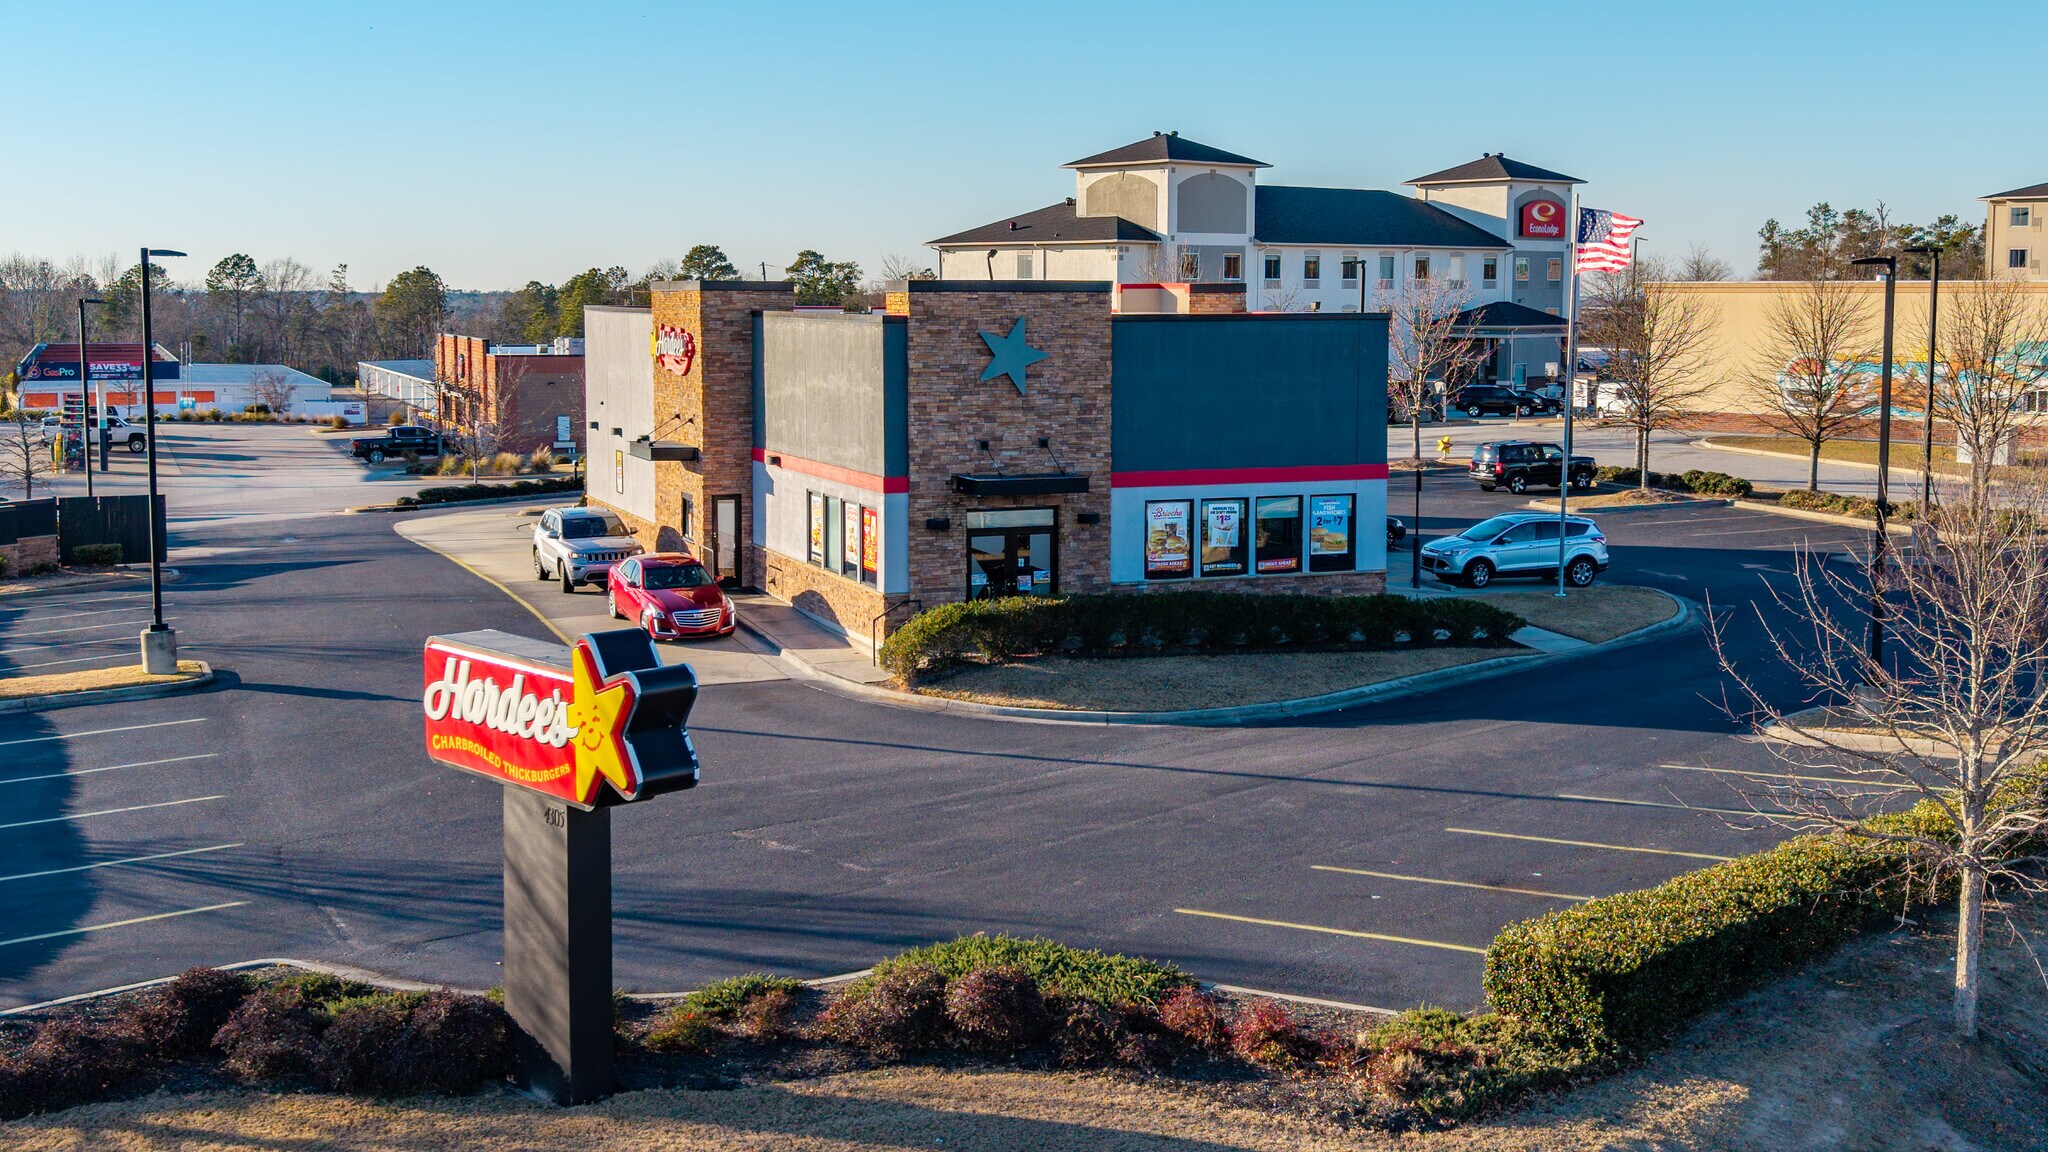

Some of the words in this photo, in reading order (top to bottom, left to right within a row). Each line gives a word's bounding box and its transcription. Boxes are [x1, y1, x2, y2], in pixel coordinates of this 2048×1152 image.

[43, 368, 75, 377] GasPro
[90, 363, 115, 371] SAVE
[1153, 506, 1183, 518] Brioche
[1316, 516, 1323, 526] 2
[1333, 516, 1343, 526] $7
[424, 657, 579, 748] Hardee's
[432, 734, 502, 769] CHARBROILED
[503, 761, 571, 782] THICKBURGERS
